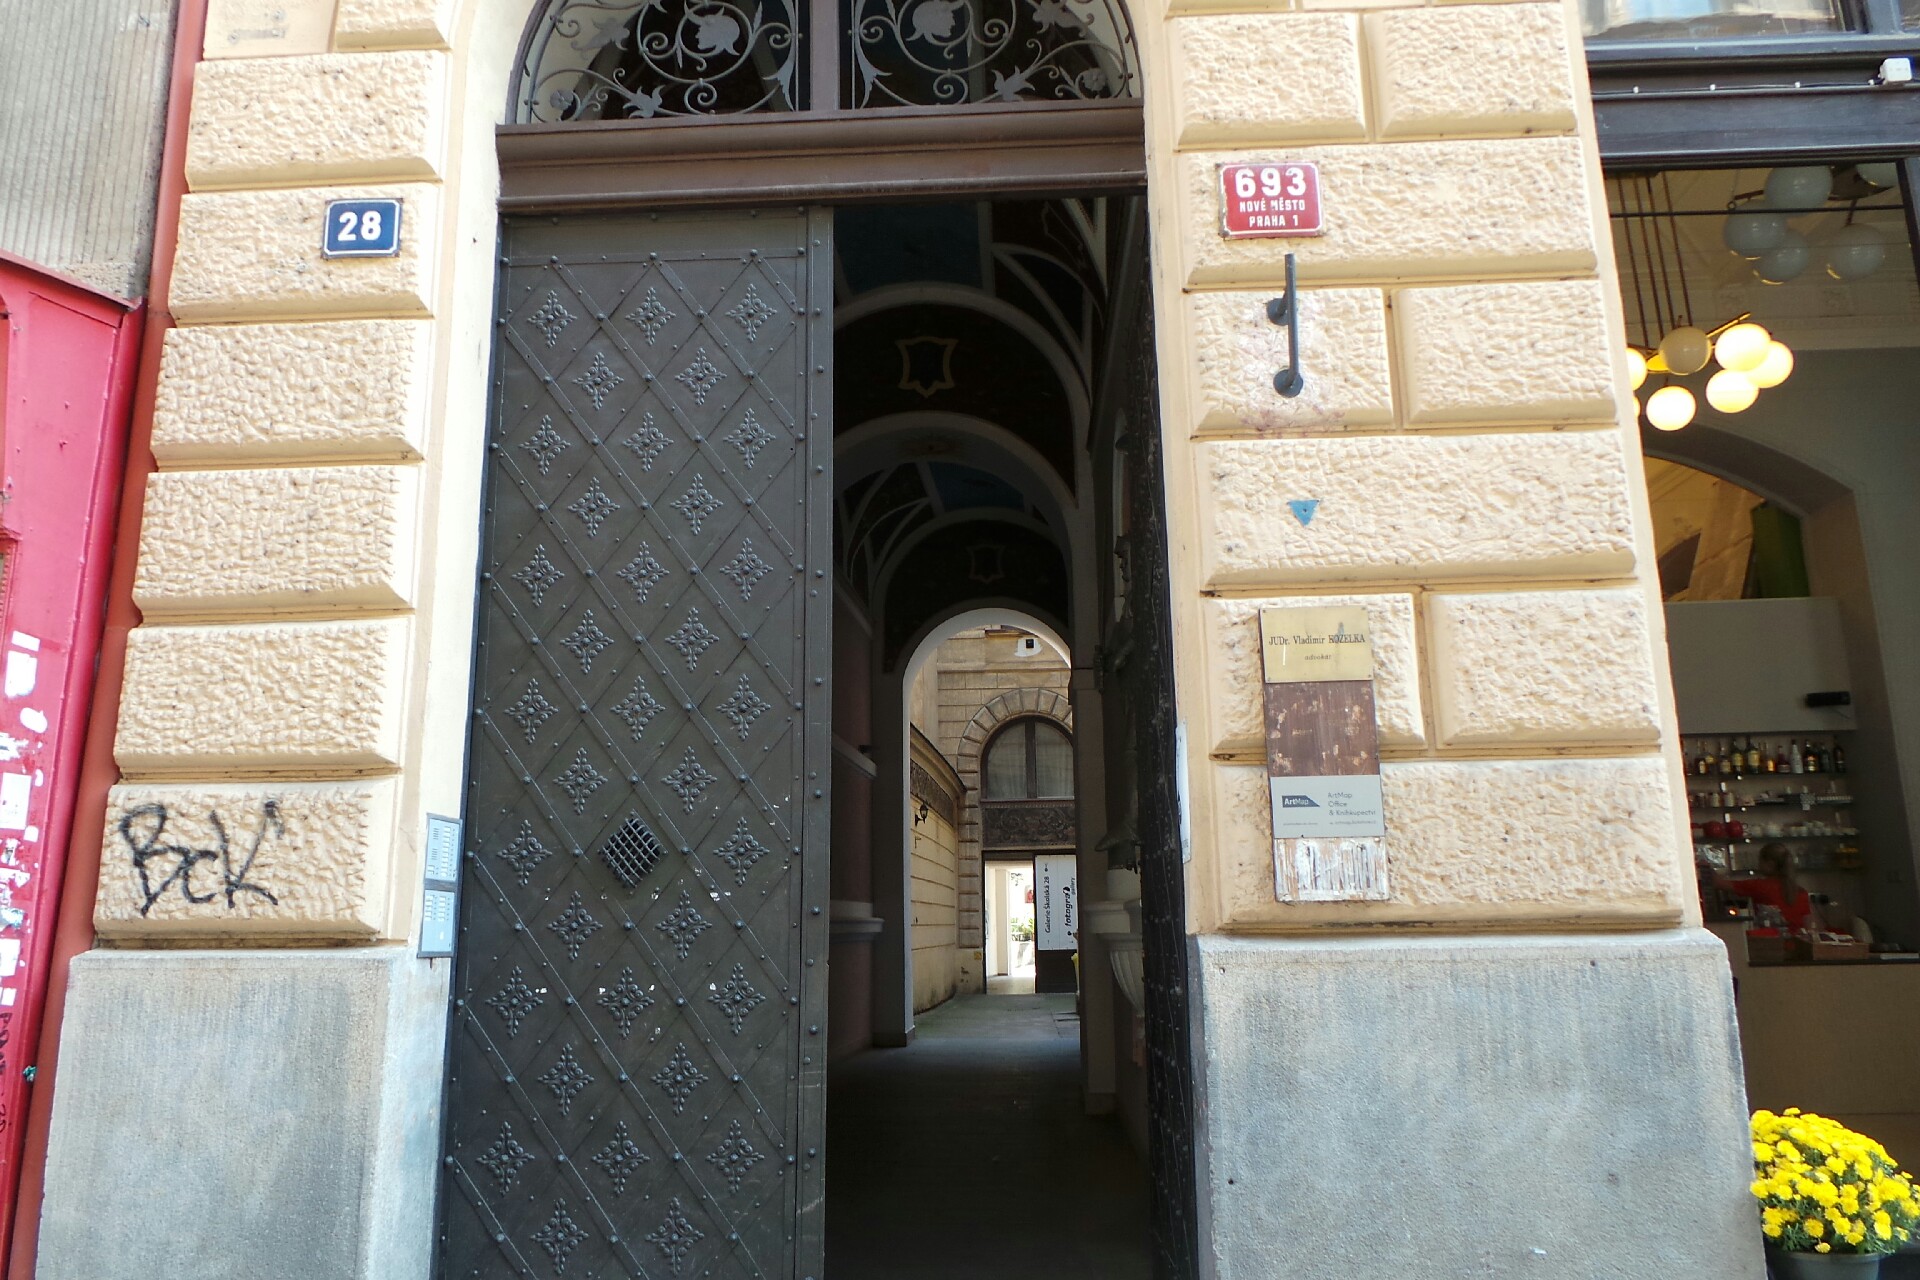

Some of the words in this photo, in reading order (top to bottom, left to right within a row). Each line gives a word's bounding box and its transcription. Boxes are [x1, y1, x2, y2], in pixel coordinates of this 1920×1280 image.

[1235, 167, 1306, 198] 693
[1239, 198, 1266, 213] NOVÉ
[1271, 197, 1305, 212] MĚSTO
[337, 210, 382, 241] 28
[1249, 215, 1286, 227] PRAHA
[1292, 215, 1299, 226] 1
[1268, 636, 1290, 646] JUDr.
[1284, 798, 1309, 806] ArtMap
[1043, 876, 1050, 884] 28
